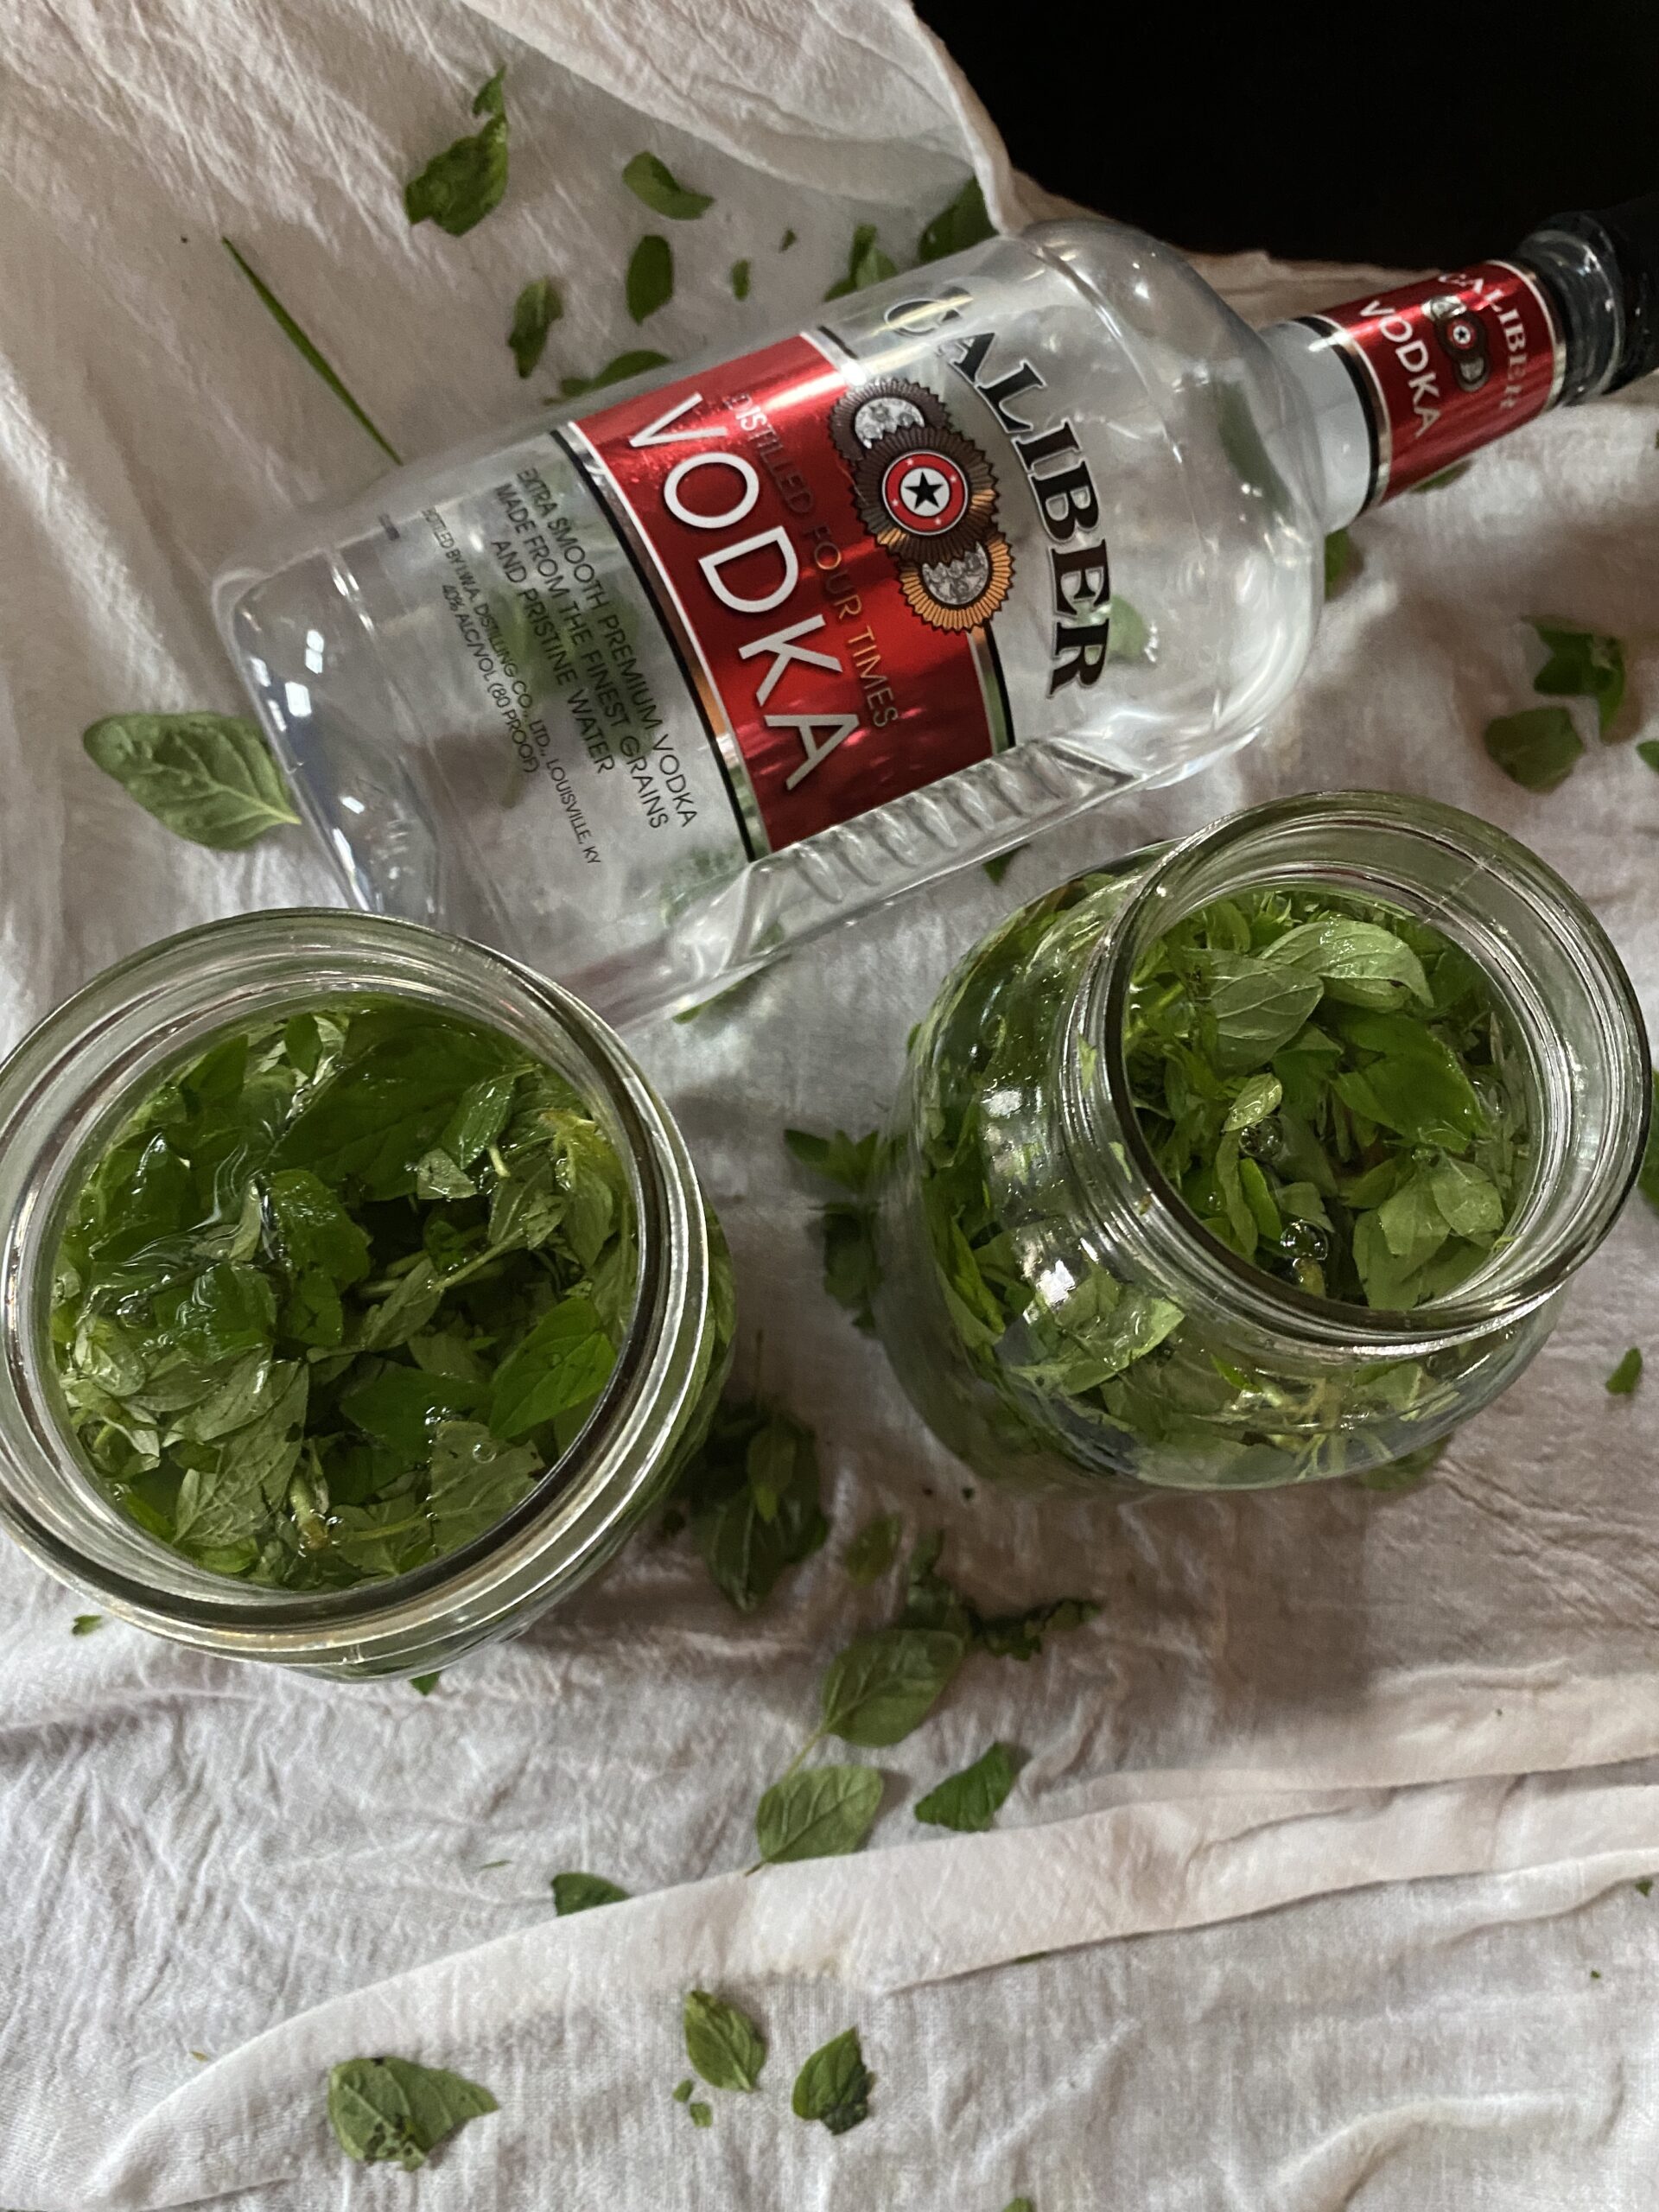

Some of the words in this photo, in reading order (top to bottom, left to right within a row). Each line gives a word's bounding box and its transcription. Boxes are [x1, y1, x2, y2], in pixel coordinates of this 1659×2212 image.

[884, 286, 1111, 699] CALIBER
[1359, 299, 1442, 439] VODKA
[442, 584, 466, 612] 40%
[454, 613, 497, 682] ALC/VOL
[486, 682, 512, 709] (80
[501, 709, 540, 773] PROOF)
[445, 548, 466, 564] BY
[473, 602, 518, 677] DISTILLING
[545, 759, 592, 845] LOUISVILLE,
[582, 846, 601, 864] KY
[491, 541, 528, 583] AND
[517, 588, 578, 686] PRISTINE
[567, 689, 615, 774] WATER
[495, 482, 537, 534] MADE
[523, 535, 570, 599] FROM
[559, 601, 594, 645] THE
[581, 650, 631, 727] FINEST
[620, 735, 669, 829] GRAINS
[517, 467, 557, 518] EXTRA
[547, 517, 611, 611] SMOOTH
[597, 614, 663, 730] PREMIUM
[652, 734, 697, 827] VODKA
[628, 392, 860, 791] VODKA
[723, 392, 816, 514] DISTILLED
[804, 523, 861, 621] FOUR
[847, 625, 899, 728] TIMES
